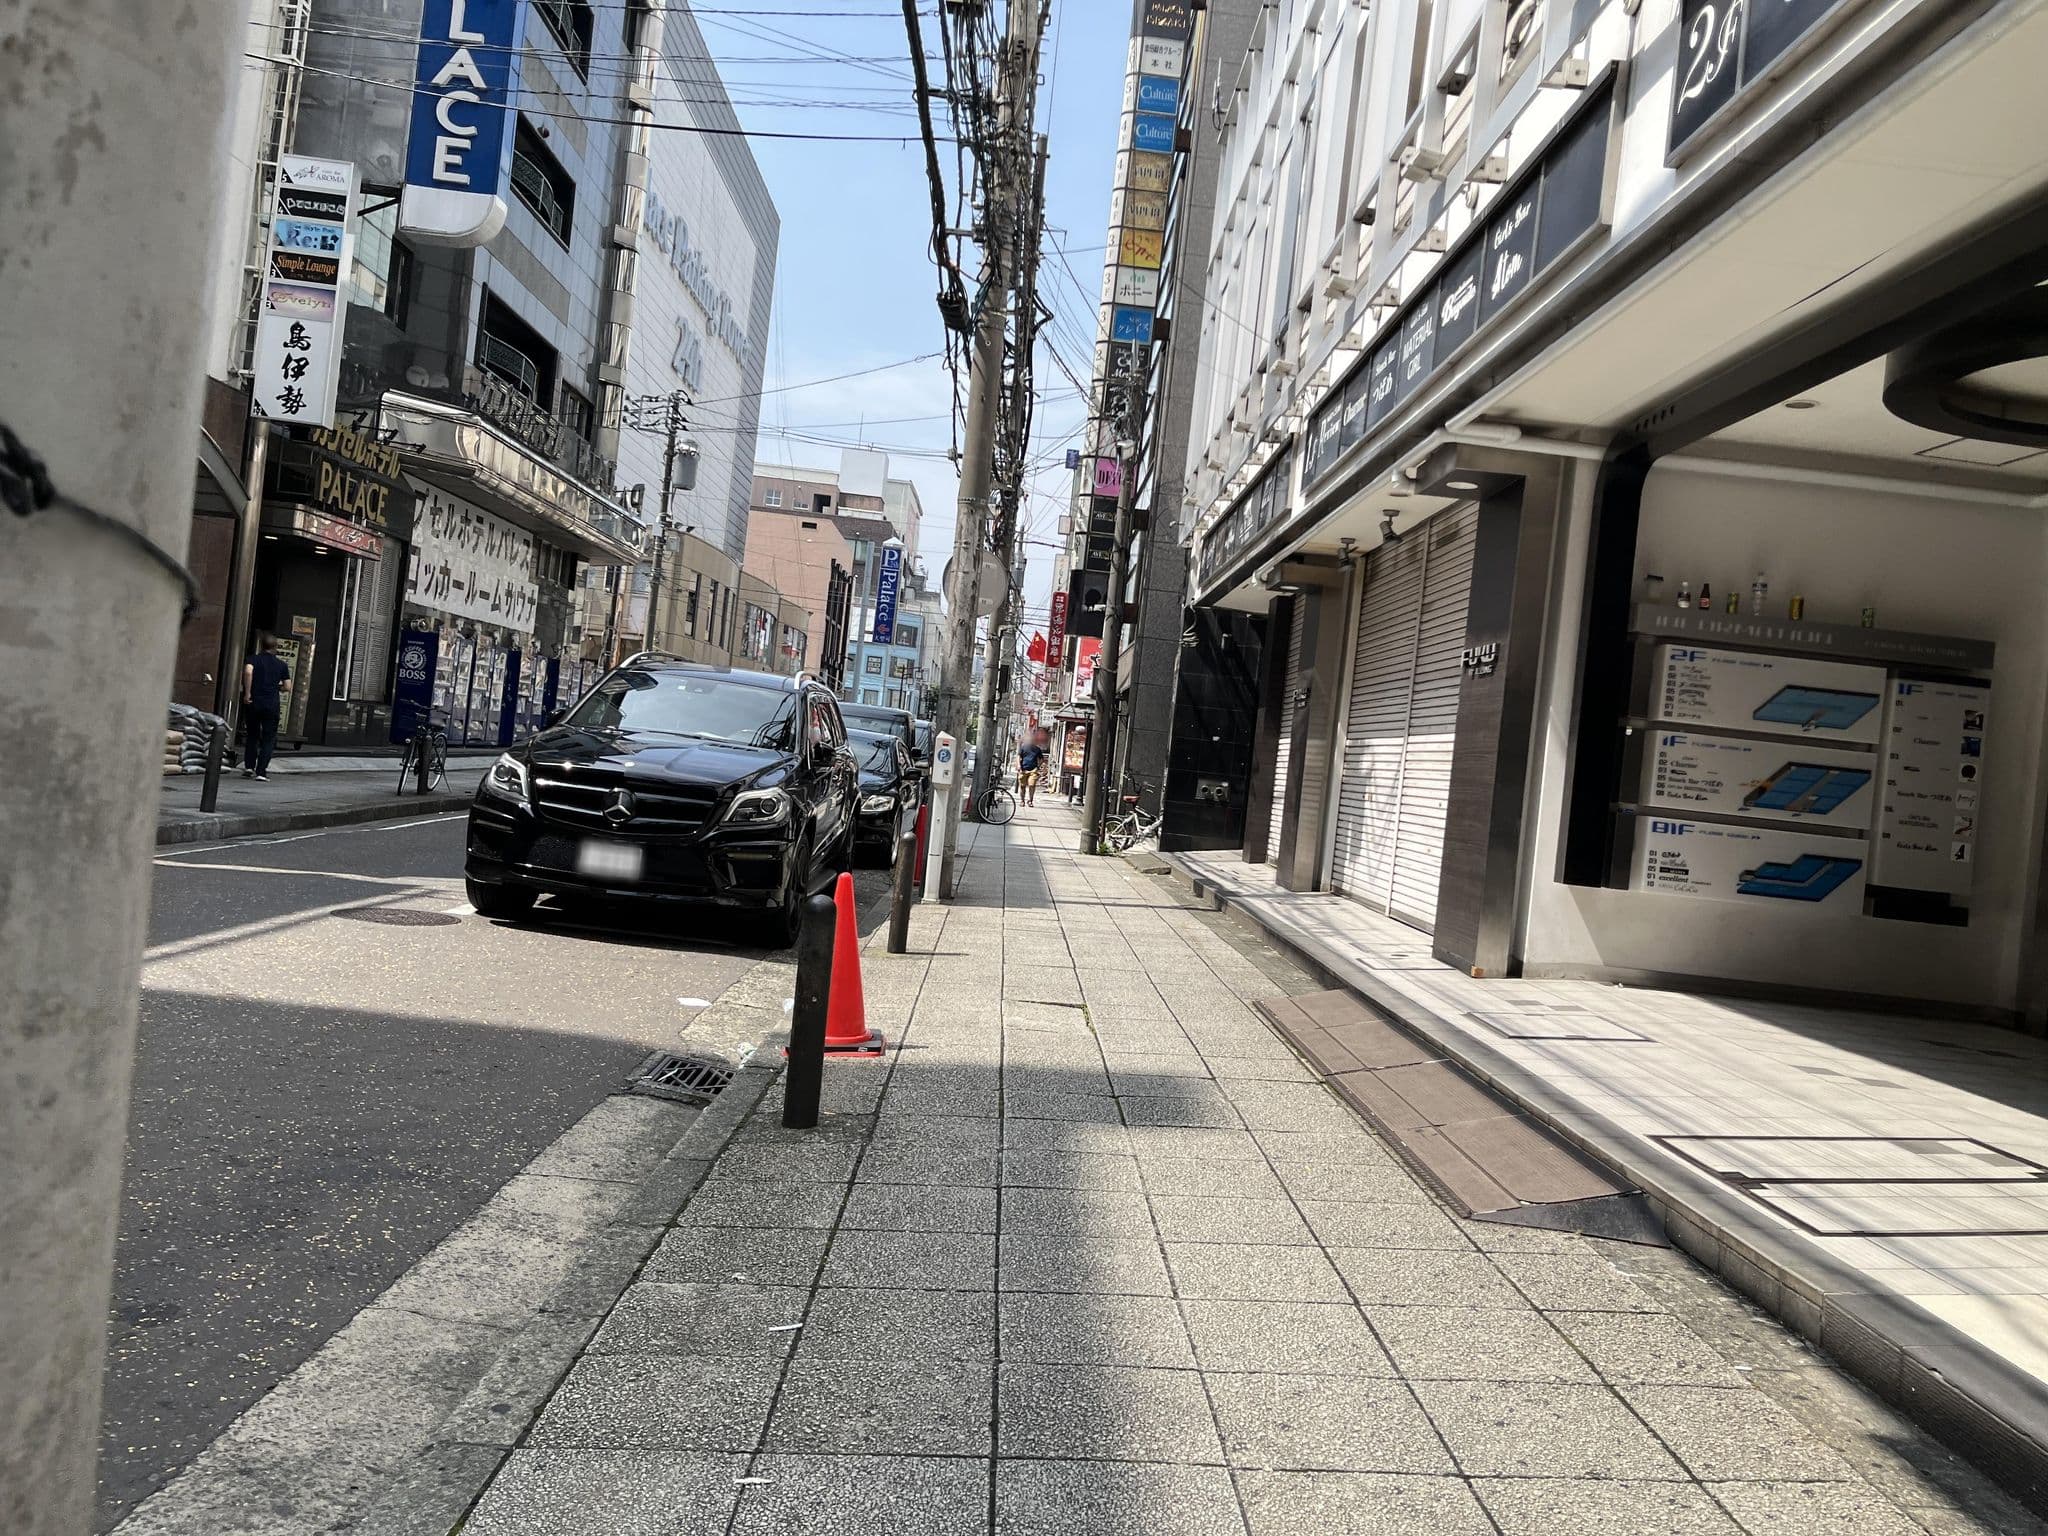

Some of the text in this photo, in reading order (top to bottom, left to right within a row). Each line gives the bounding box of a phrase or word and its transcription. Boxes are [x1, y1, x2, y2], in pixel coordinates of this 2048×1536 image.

[431, 0, 487, 185] LACE
[276, 255, 336, 276] Simple Lounge
[319, 460, 390, 527] PALACE
[882, 549, 899, 568] P
[878, 570, 897, 621] Palace
[1670, 648, 1707, 662] 2F
[399, 668, 426, 680] BOSS
[1898, 683, 1924, 695] 1F
[1662, 735, 1688, 747] 1F
[1652, 821, 1696, 835] B1F
[1658, 875, 1689, 883] excellent
